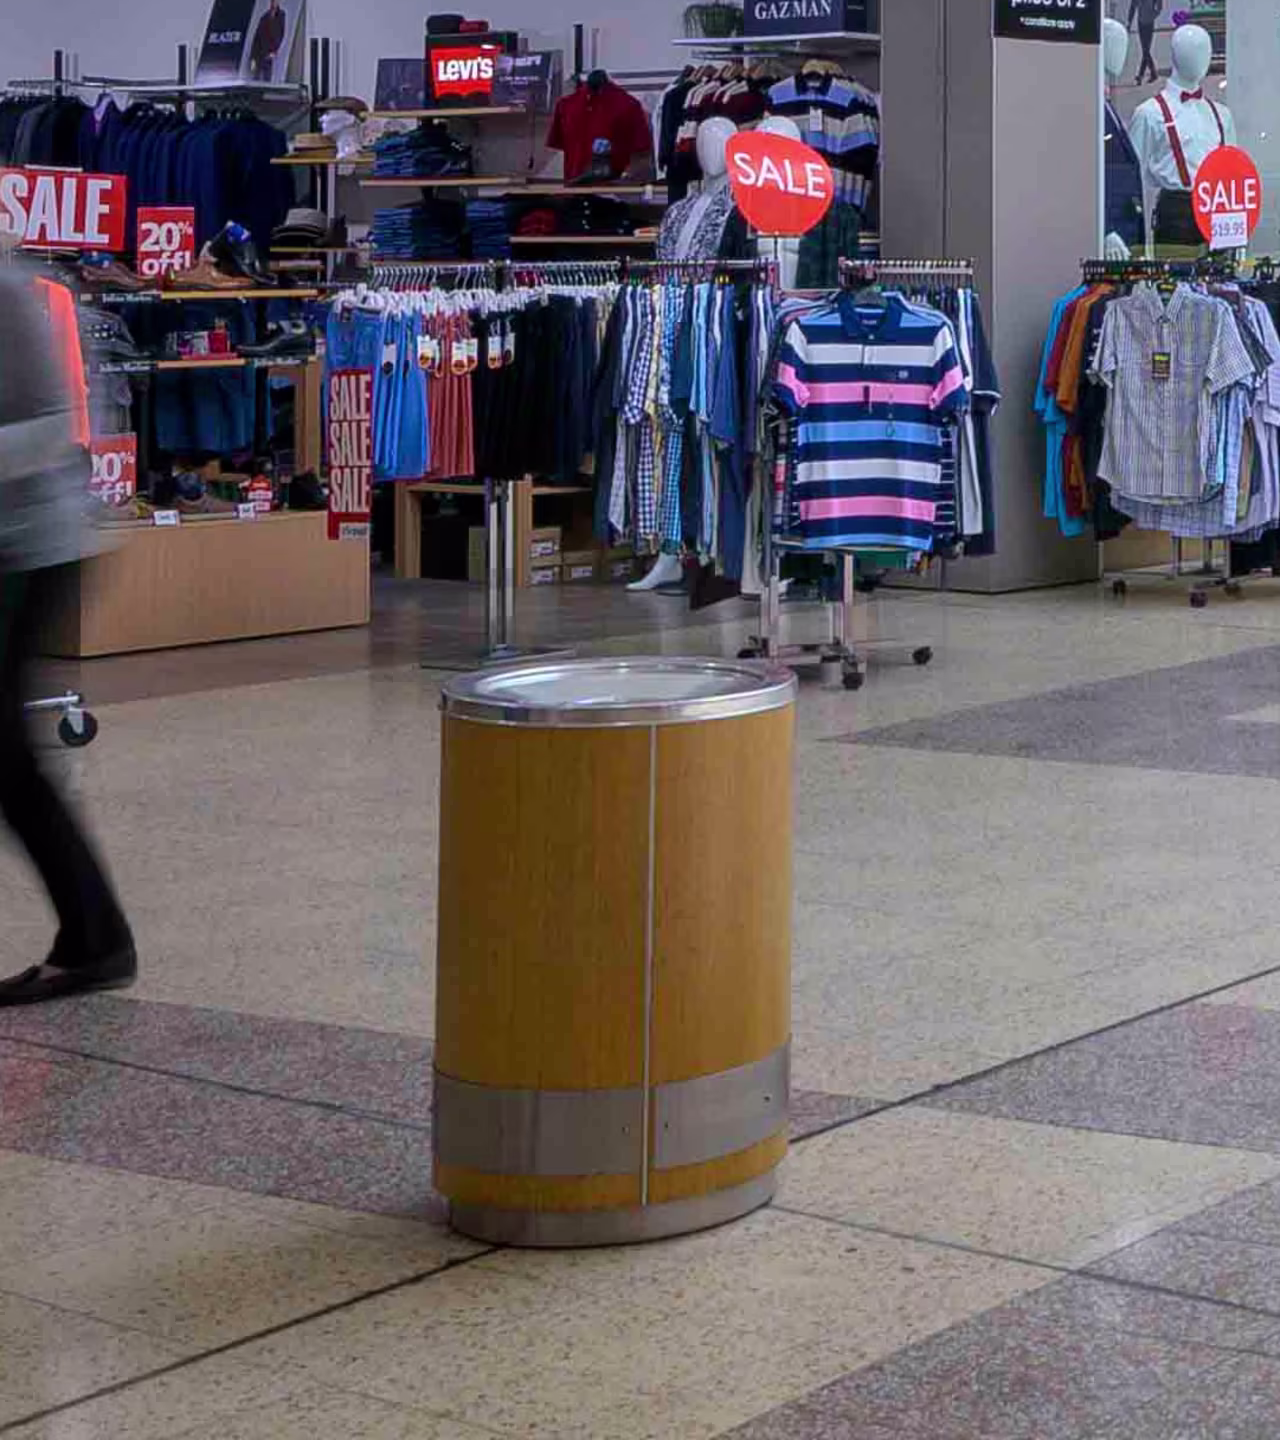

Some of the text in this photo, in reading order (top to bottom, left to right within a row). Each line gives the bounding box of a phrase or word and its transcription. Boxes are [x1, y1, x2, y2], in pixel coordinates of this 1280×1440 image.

[734, 152, 827, 199] SALE
[1198, 178, 1257, 212] SALE
[0, 173, 112, 244] SALE
[140, 220, 193, 251] 20%
[331, 374, 371, 420] SALE
[331, 422, 370, 466] SALE
[331, 468, 370, 512] SALE
